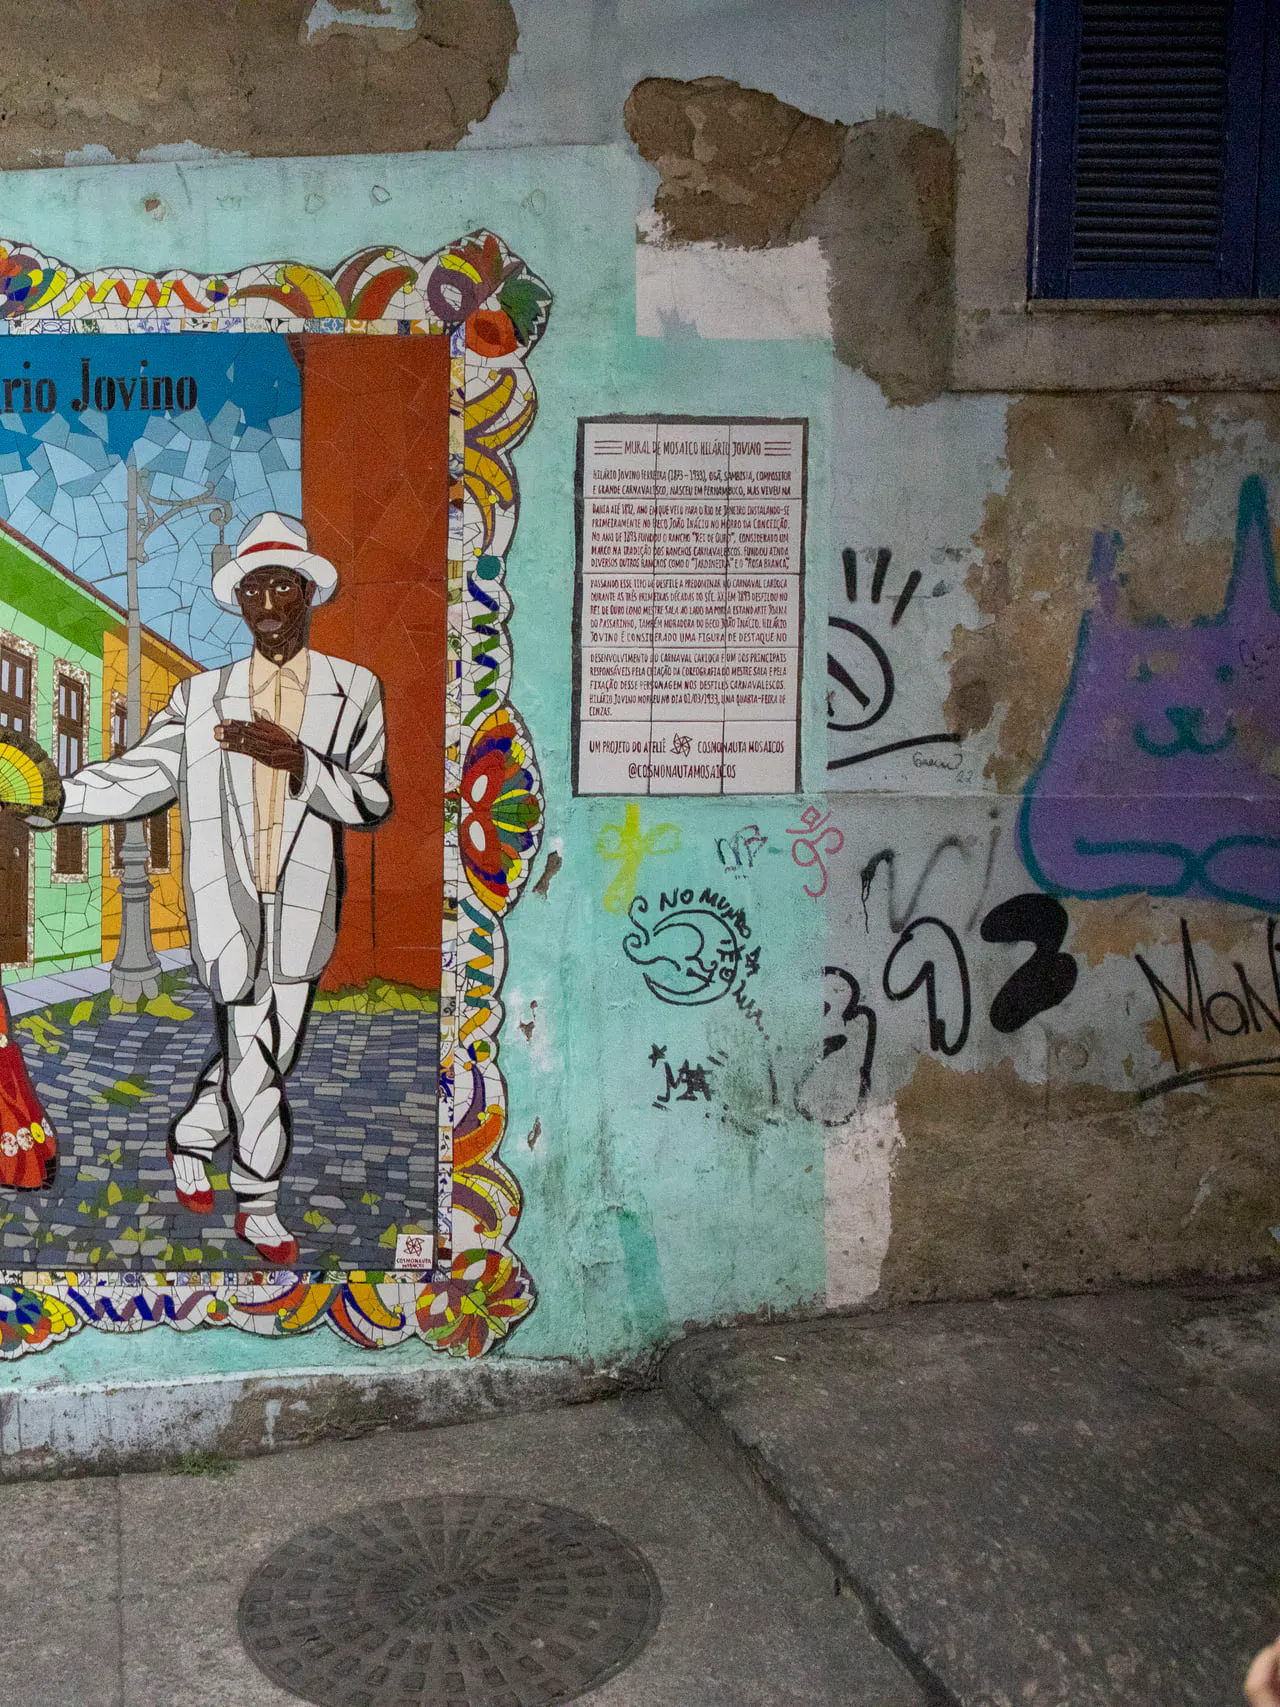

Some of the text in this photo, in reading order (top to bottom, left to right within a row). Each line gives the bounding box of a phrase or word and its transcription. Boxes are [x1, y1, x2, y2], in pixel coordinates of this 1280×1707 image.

[71, 357, 198, 412] Jovino
[624, 438, 762, 457] MURAL DE MOSAICO HILÁRIO JOVINO
[590, 631, 618, 643] JOVINO
[627, 632, 677, 642] CONSIDERADO
[679, 632, 696, 643] UMA
[739, 632, 775, 645] DESTAQUE
[589, 740, 785, 754] UM PROJETO DO COSMONAUTA MOSAICOS
[628, 762, 737, 779] @COSMONAUTAMOSAICOS
[659, 887, 694, 912] NO
